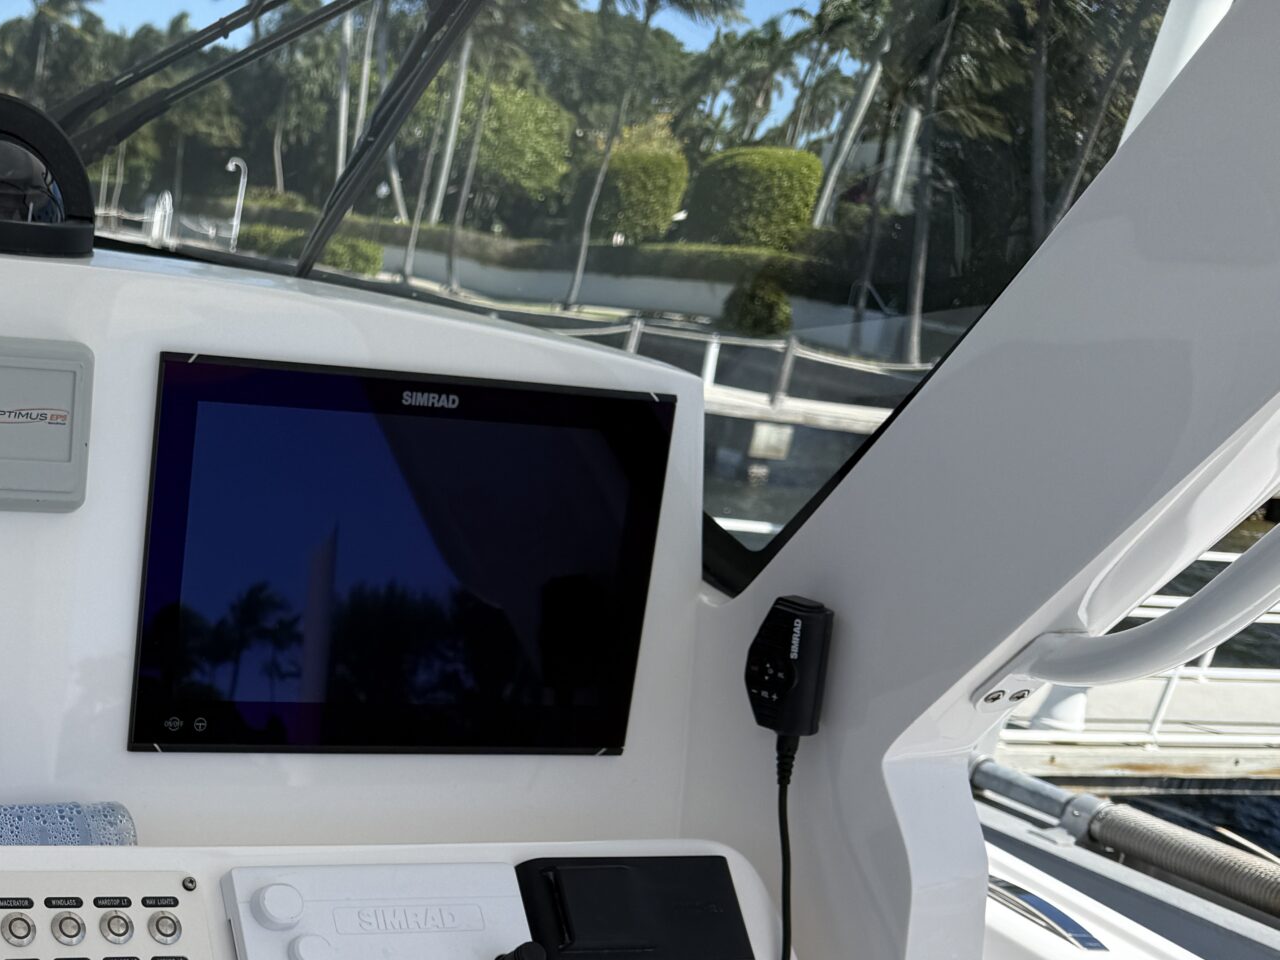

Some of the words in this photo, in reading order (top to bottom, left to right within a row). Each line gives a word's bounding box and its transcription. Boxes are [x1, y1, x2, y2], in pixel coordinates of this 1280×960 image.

[402, 391, 460, 409] SIMRAD
[789, 618, 802, 660] SIMRAD
[0, 899, 29, 907] MACERATOR
[357, 907, 460, 931] SIMRAD
